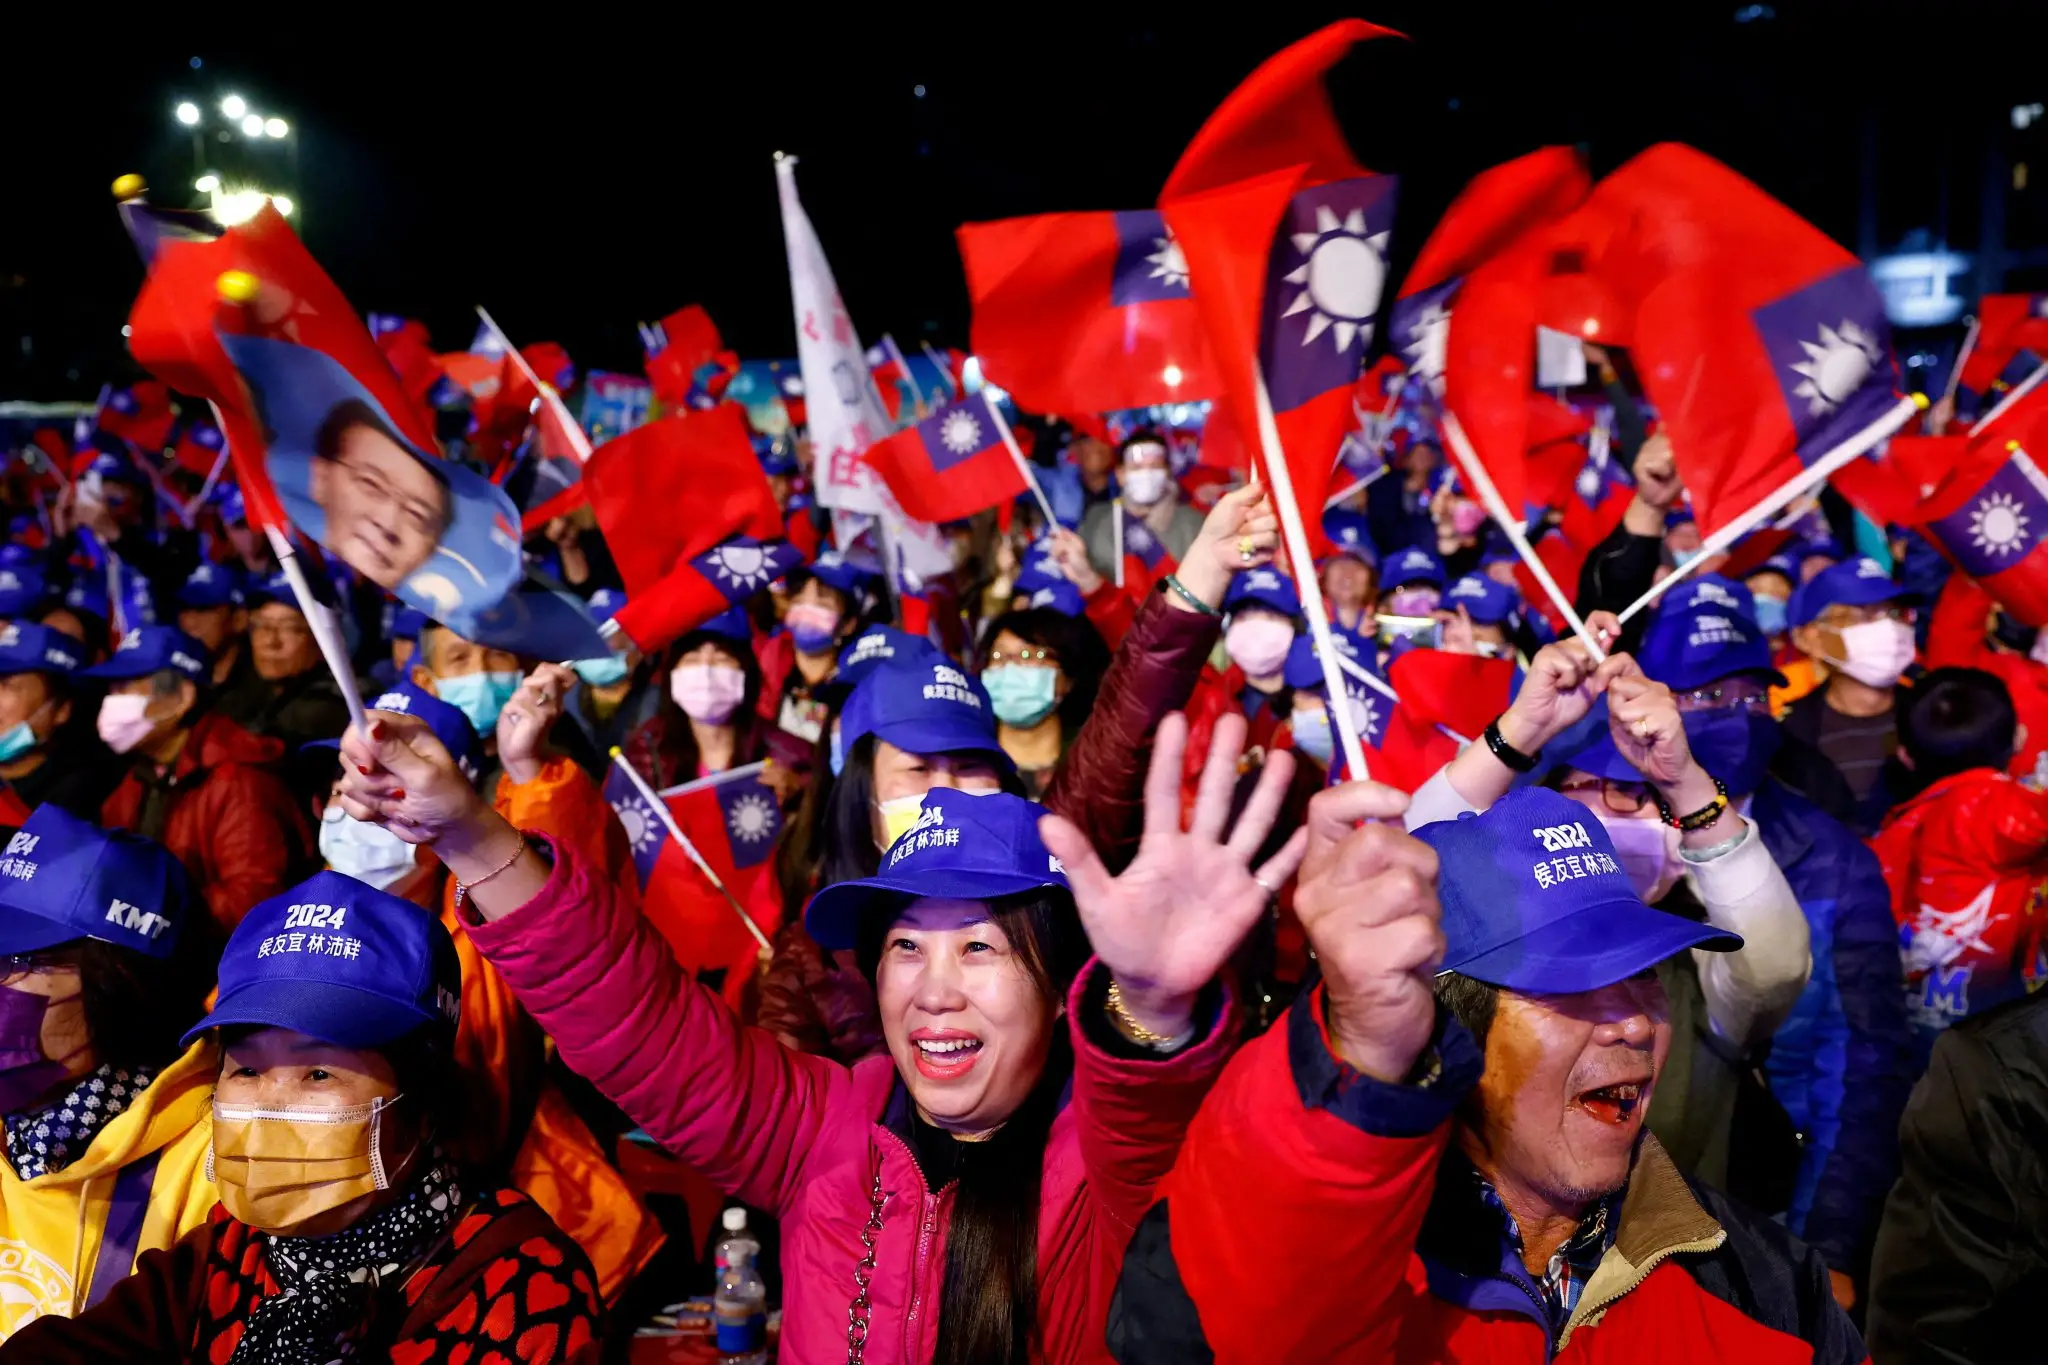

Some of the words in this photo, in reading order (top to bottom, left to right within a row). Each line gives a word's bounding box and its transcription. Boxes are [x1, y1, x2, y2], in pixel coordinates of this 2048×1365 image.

[1533, 822, 1593, 852] 2024
[105, 898, 171, 939] KMT
[284, 903, 347, 930] 2024
[257, 931, 361, 960] 侯友宜林沛祥
[437, 982, 461, 1025] KM
